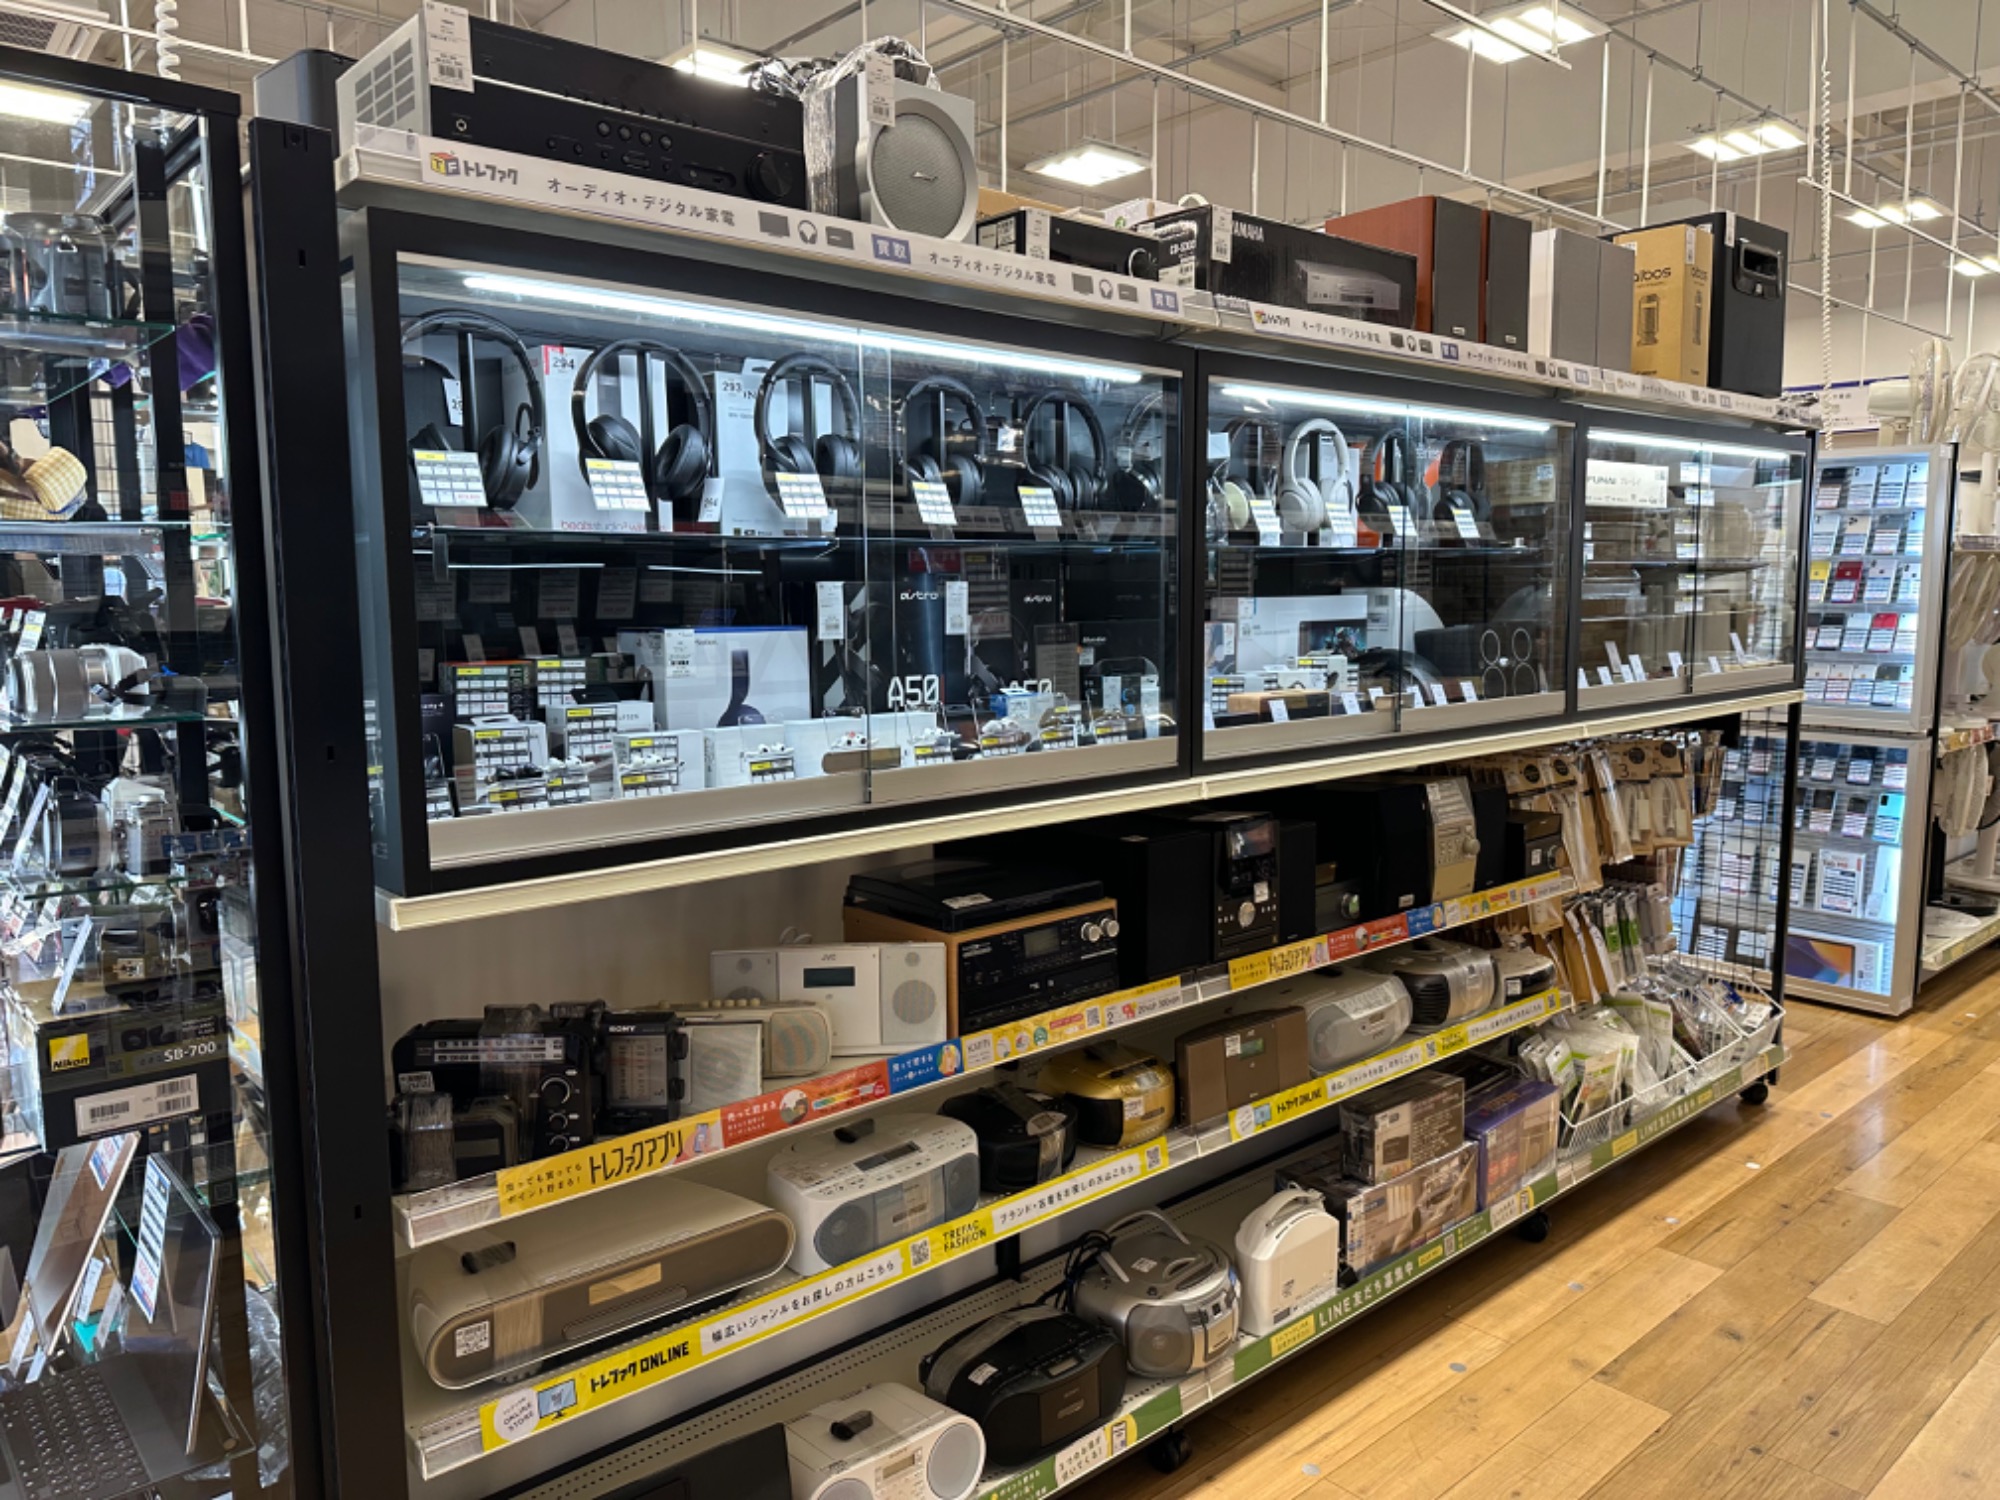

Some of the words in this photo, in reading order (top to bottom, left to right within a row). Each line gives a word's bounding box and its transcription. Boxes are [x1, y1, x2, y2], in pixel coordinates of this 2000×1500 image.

[463, 160, 518, 186] トレファク
[548, 178, 736, 226] オーディオ・デジタル家電
[888, 674, 940, 709] A50
[608, 1024, 637, 1033] SONY
[53, 1056, 90, 1071] Nikon
[163, 1040, 217, 1063] SB-700
[589, 1130, 684, 1185] トレファクアプリ
[943, 1230, 987, 1253] FASHION
[711, 1260, 895, 1344] 幅広いジャンルをお探しの方はこちら
[590, 1361, 637, 1393] トレファク
[640, 1341, 690, 1373] ONLINE
